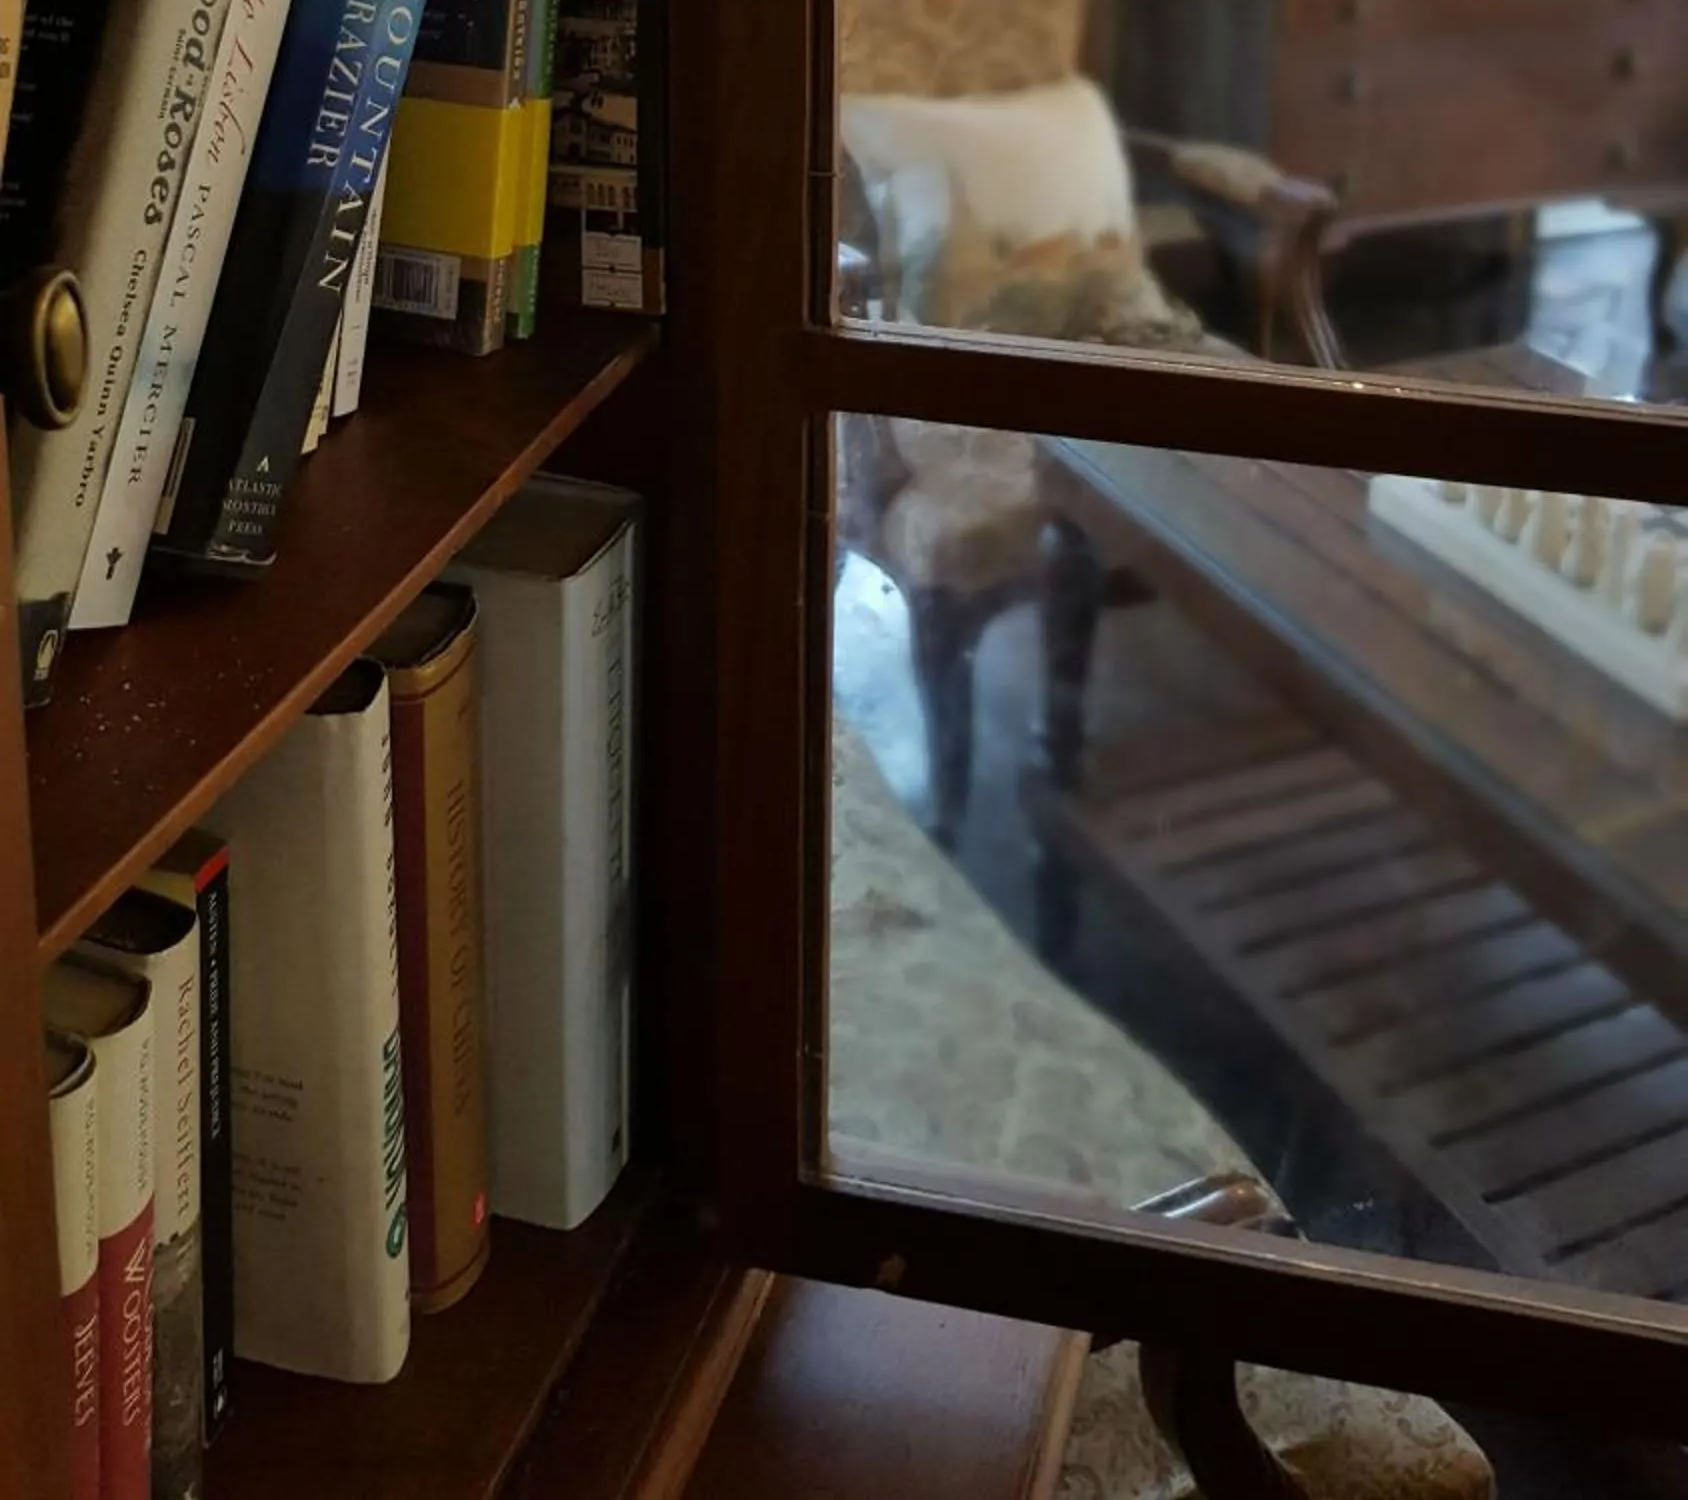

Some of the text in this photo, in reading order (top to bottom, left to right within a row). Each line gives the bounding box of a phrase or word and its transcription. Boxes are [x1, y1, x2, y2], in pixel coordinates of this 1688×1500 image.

[143, 86, 198, 227] Roses
[208, 36, 255, 165] Lisbon
[74, 249, 148, 508] Chelsea Quinn Yarbro
[127, 184, 211, 485] PASCAL MERCIER
[176, 974, 196, 1218] Rachel Seiffert
[73, 1314, 98, 1428] JEEVES
